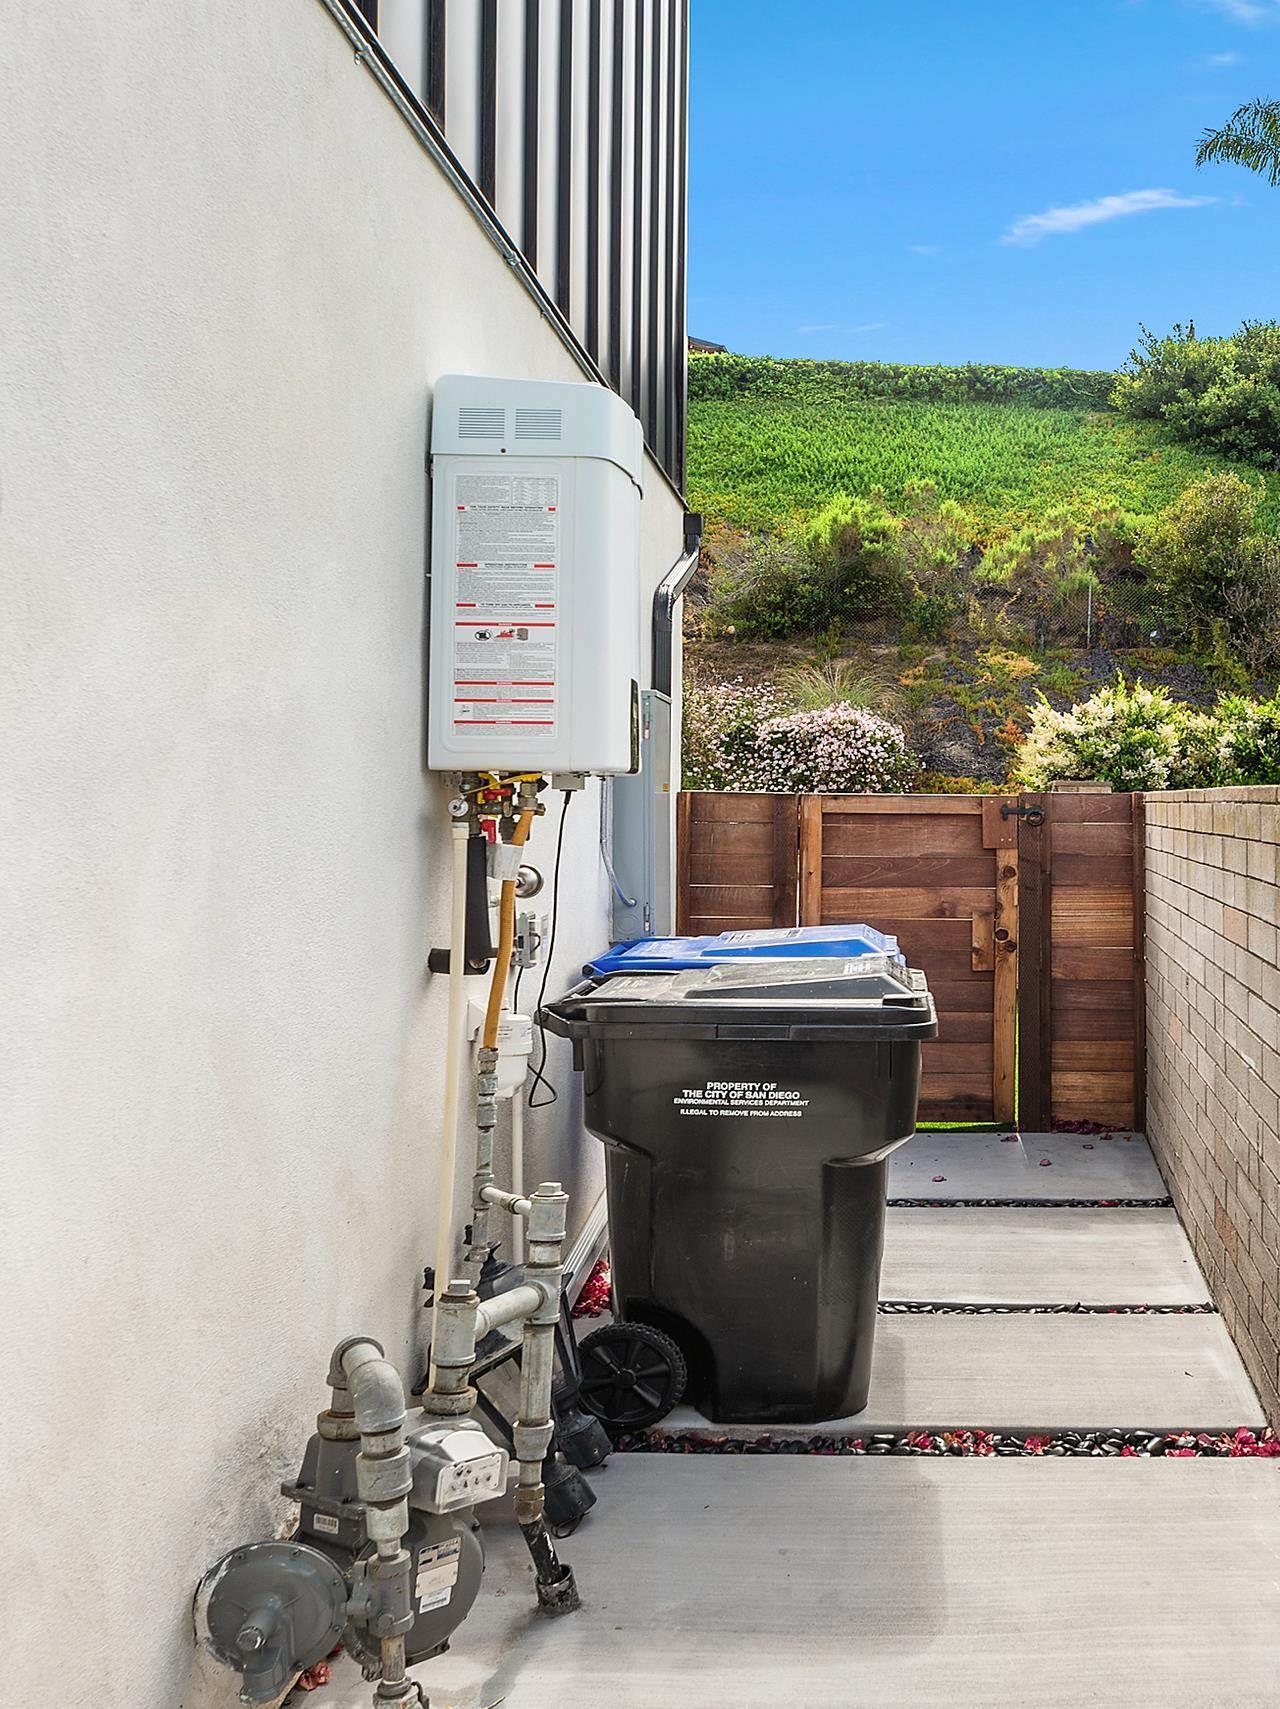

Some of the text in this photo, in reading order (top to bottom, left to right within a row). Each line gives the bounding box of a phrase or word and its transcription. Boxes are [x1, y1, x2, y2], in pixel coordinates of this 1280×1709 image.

[706, 1082, 777, 1091] PROPERTY OF
[682, 1089, 801, 1100] THE CITY OF SAN DIEGO
[673, 1097, 730, 1105] ENVIRONMENTAL
[680, 1108, 708, 1116] ILLEGAL
